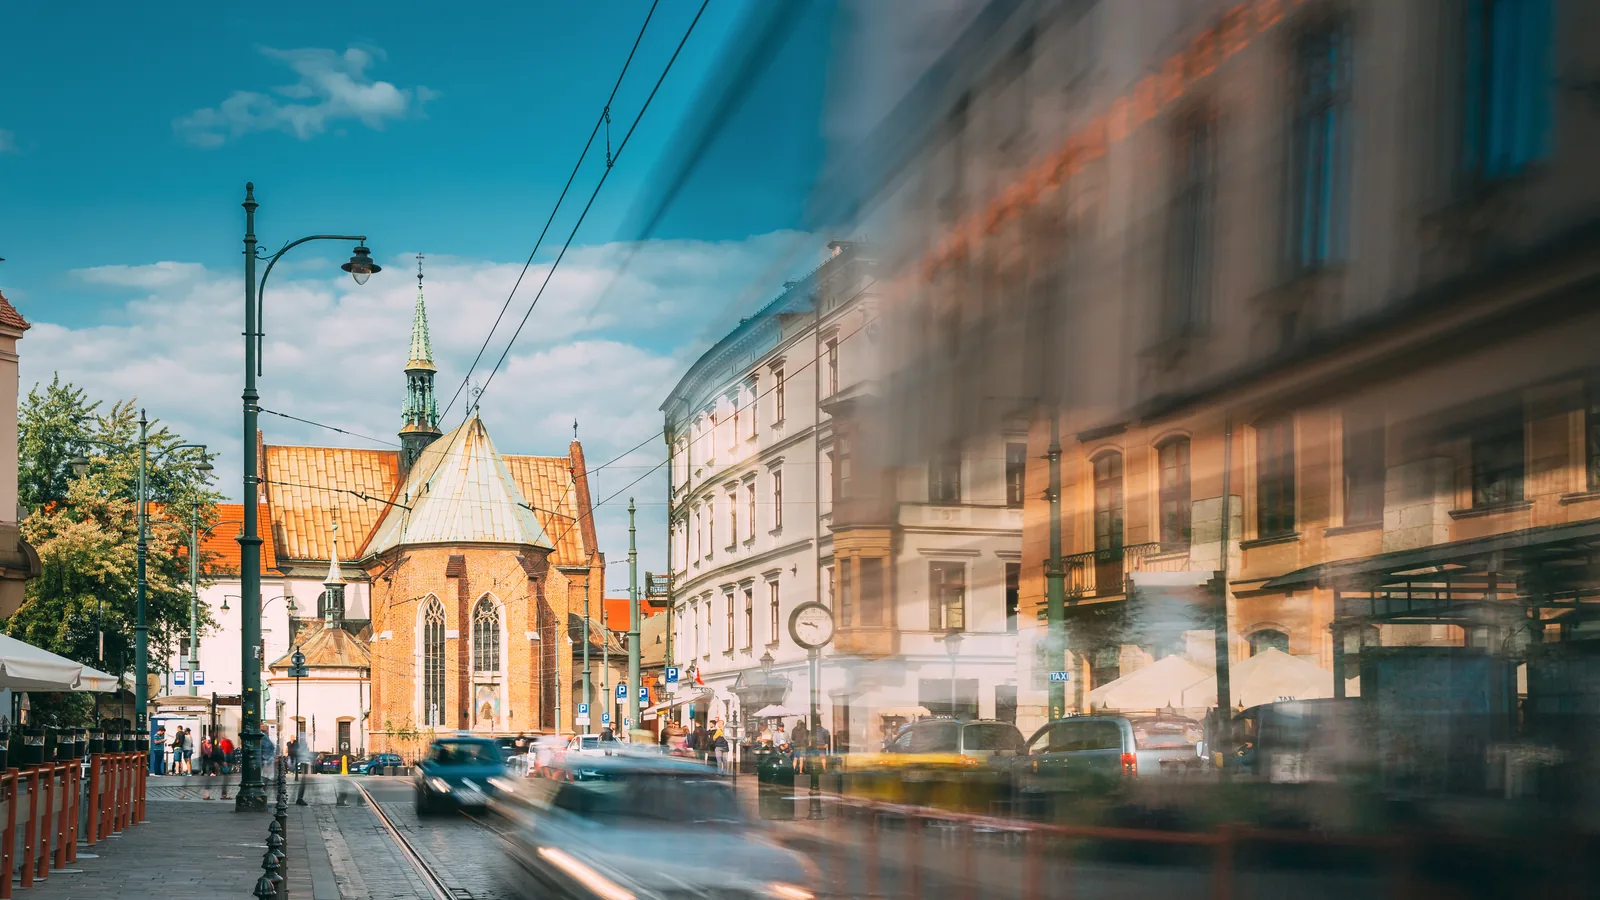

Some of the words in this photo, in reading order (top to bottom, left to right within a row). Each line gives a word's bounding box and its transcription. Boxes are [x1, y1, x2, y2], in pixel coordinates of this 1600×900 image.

[668, 669, 676, 678] P
[1051, 672, 1069, 680] TAXI
[619, 686, 625, 694] P
[640, 689, 646, 697] P
